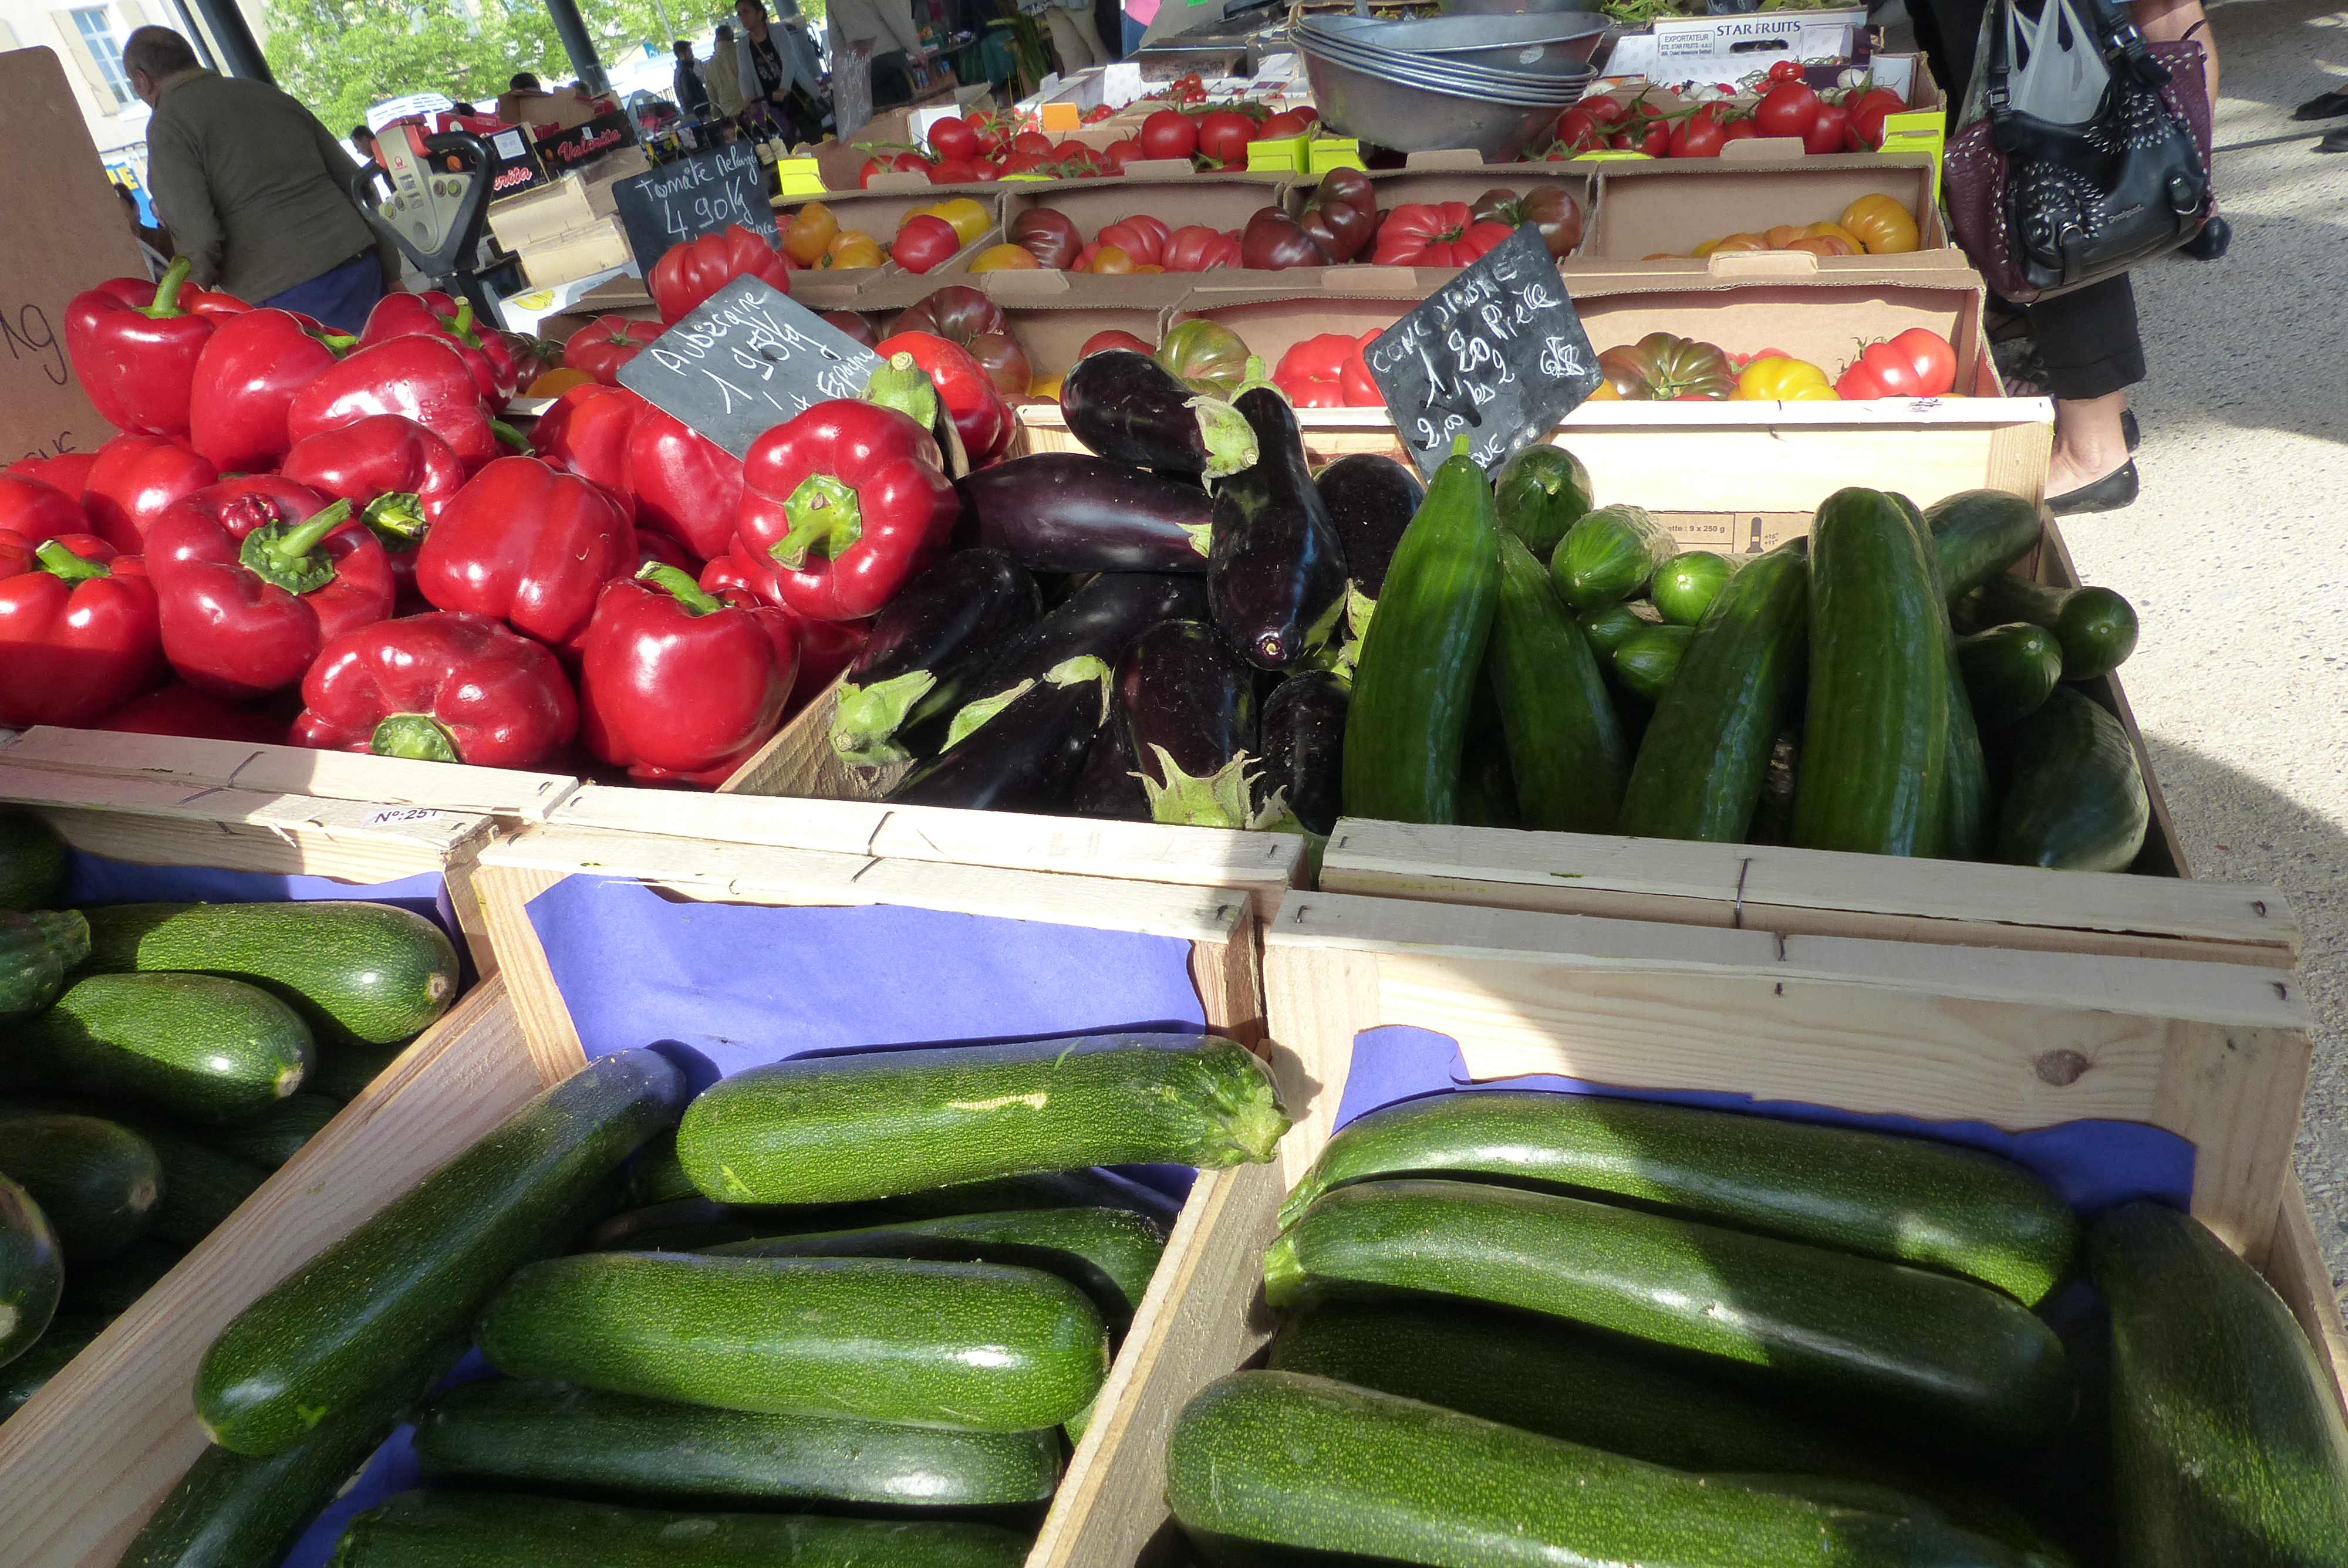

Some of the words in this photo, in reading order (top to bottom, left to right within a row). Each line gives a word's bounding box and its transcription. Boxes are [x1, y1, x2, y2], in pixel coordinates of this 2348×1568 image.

[1717, 24, 1752, 36] STAR
[1756, 21, 1801, 34] FRUITS
[1665, 34, 1709, 42] EXPORTATEUR
